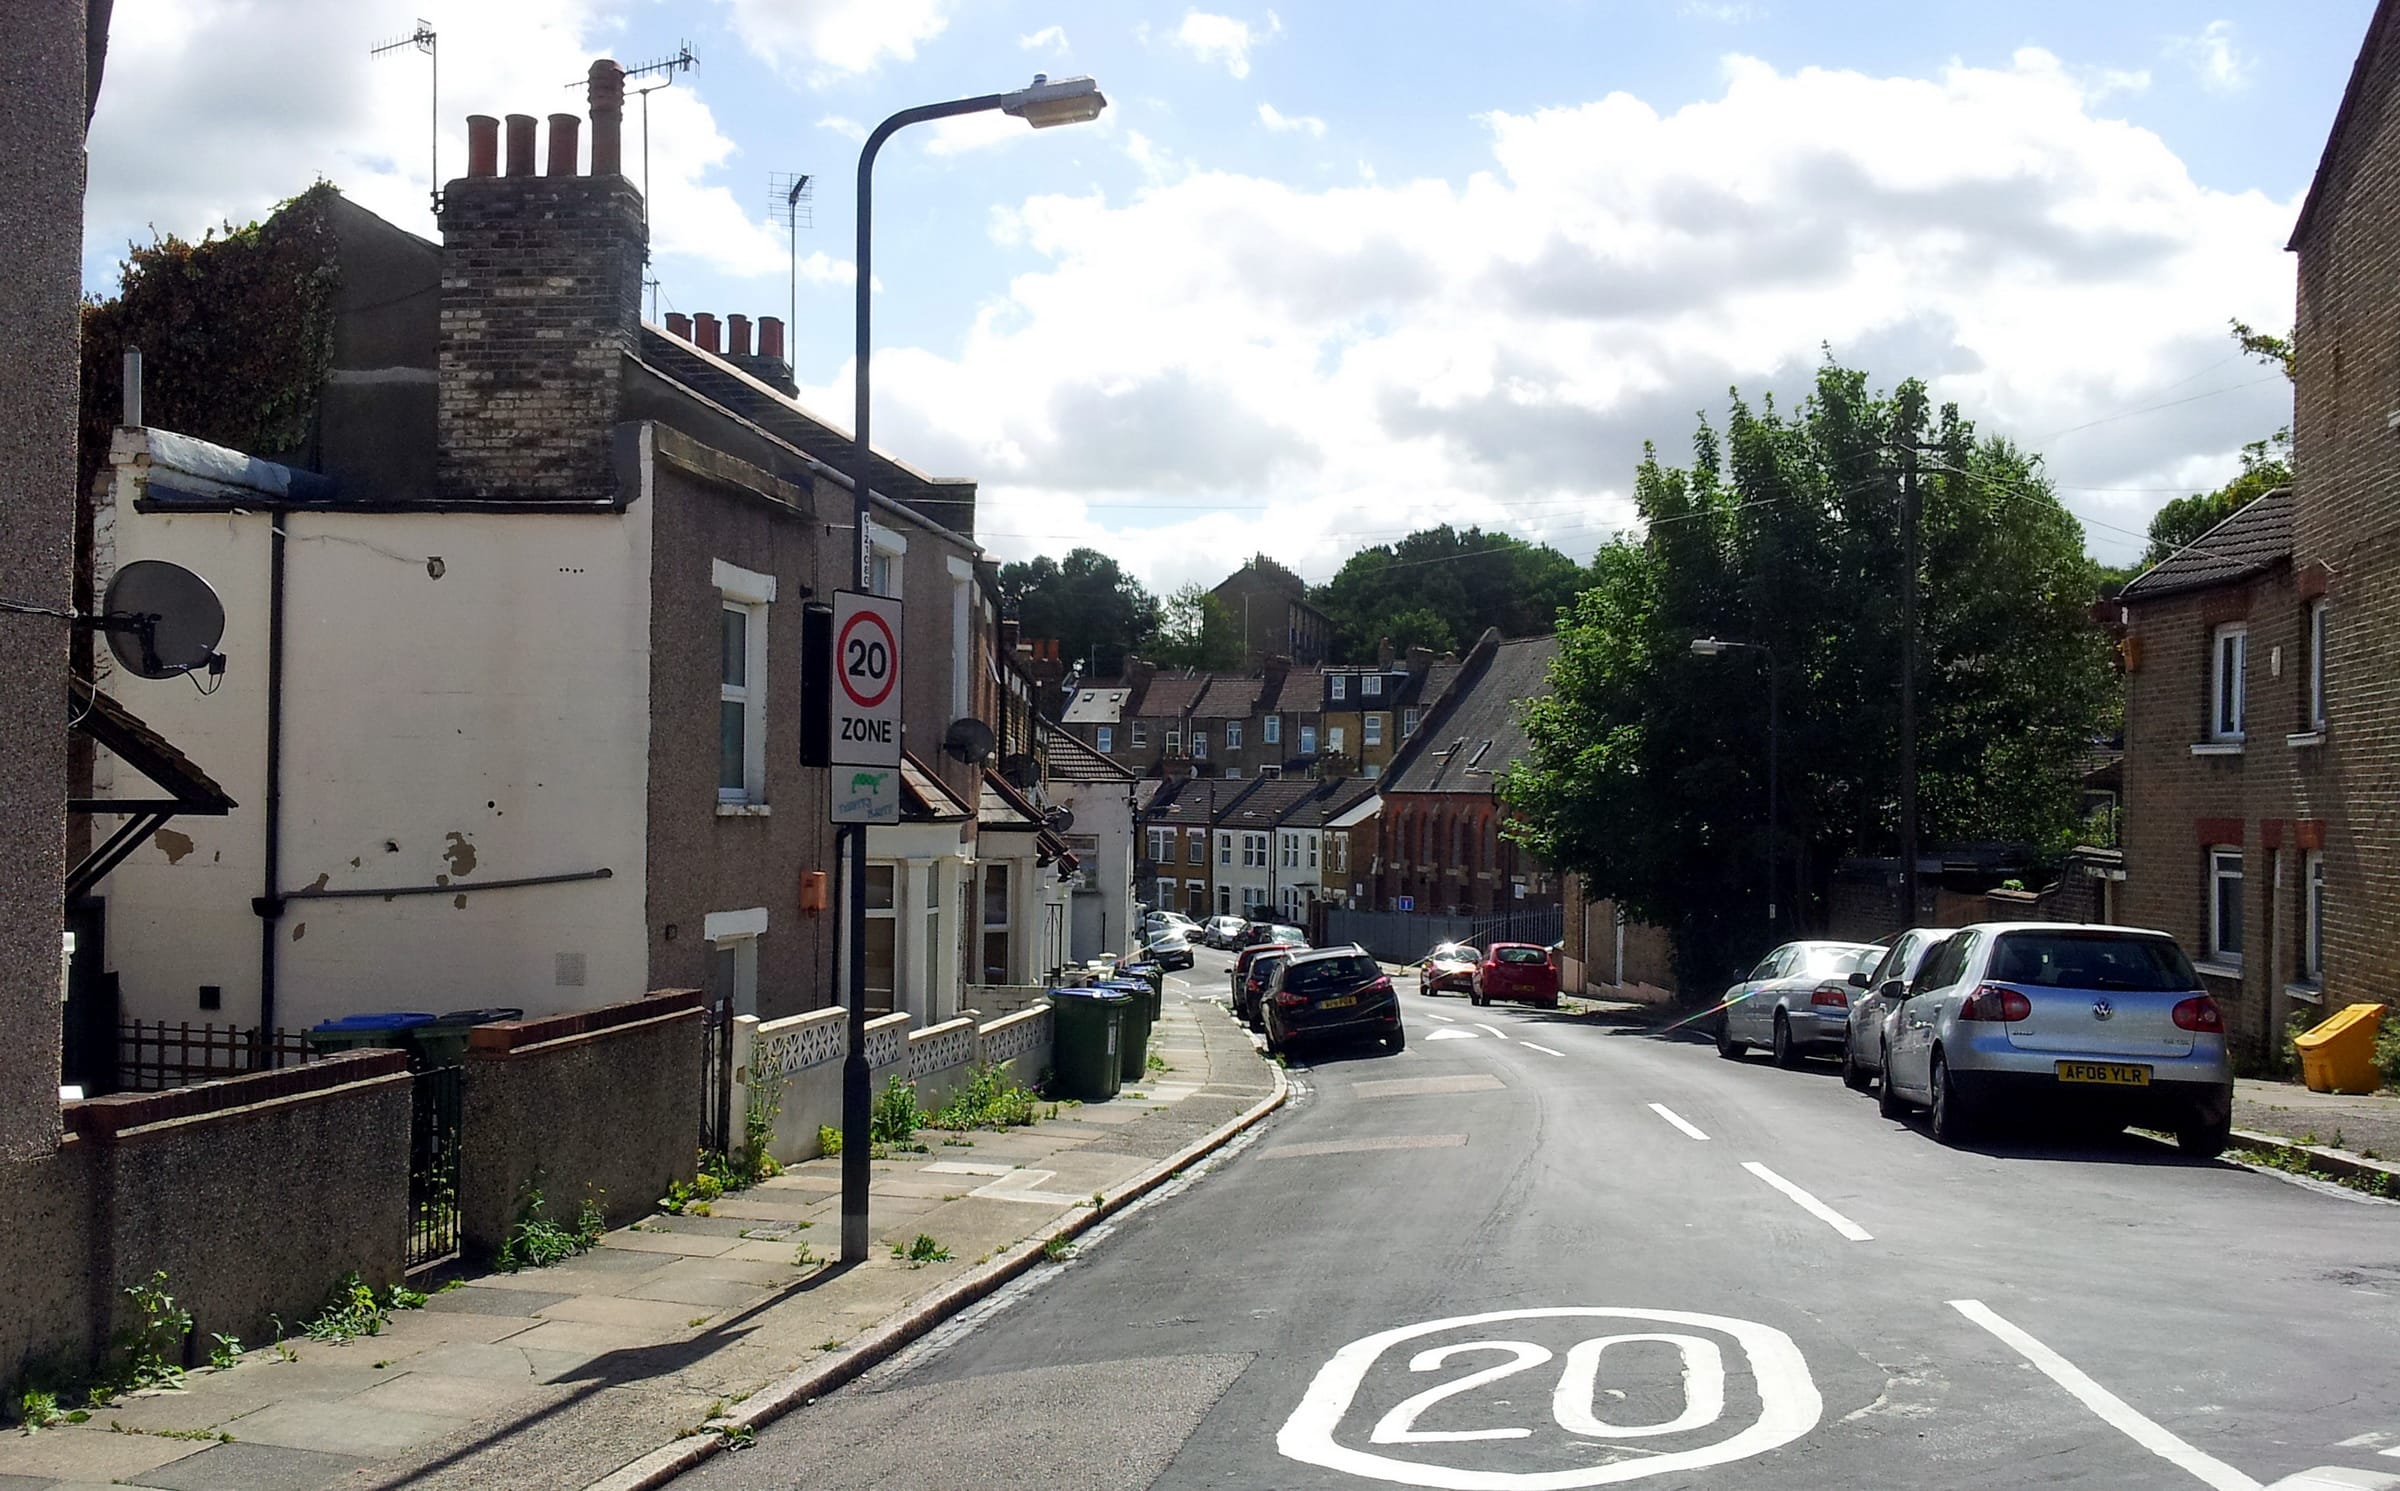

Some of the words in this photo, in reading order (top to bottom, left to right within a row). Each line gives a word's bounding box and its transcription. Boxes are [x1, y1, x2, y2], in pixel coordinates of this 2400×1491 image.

[848, 638, 887, 680] 20
[841, 717, 892, 743] ZONE
[2065, 1064, 2107, 1081] AF06
[2111, 1067, 2142, 1083] YLR
[1369, 1333, 1726, 1445] 20
